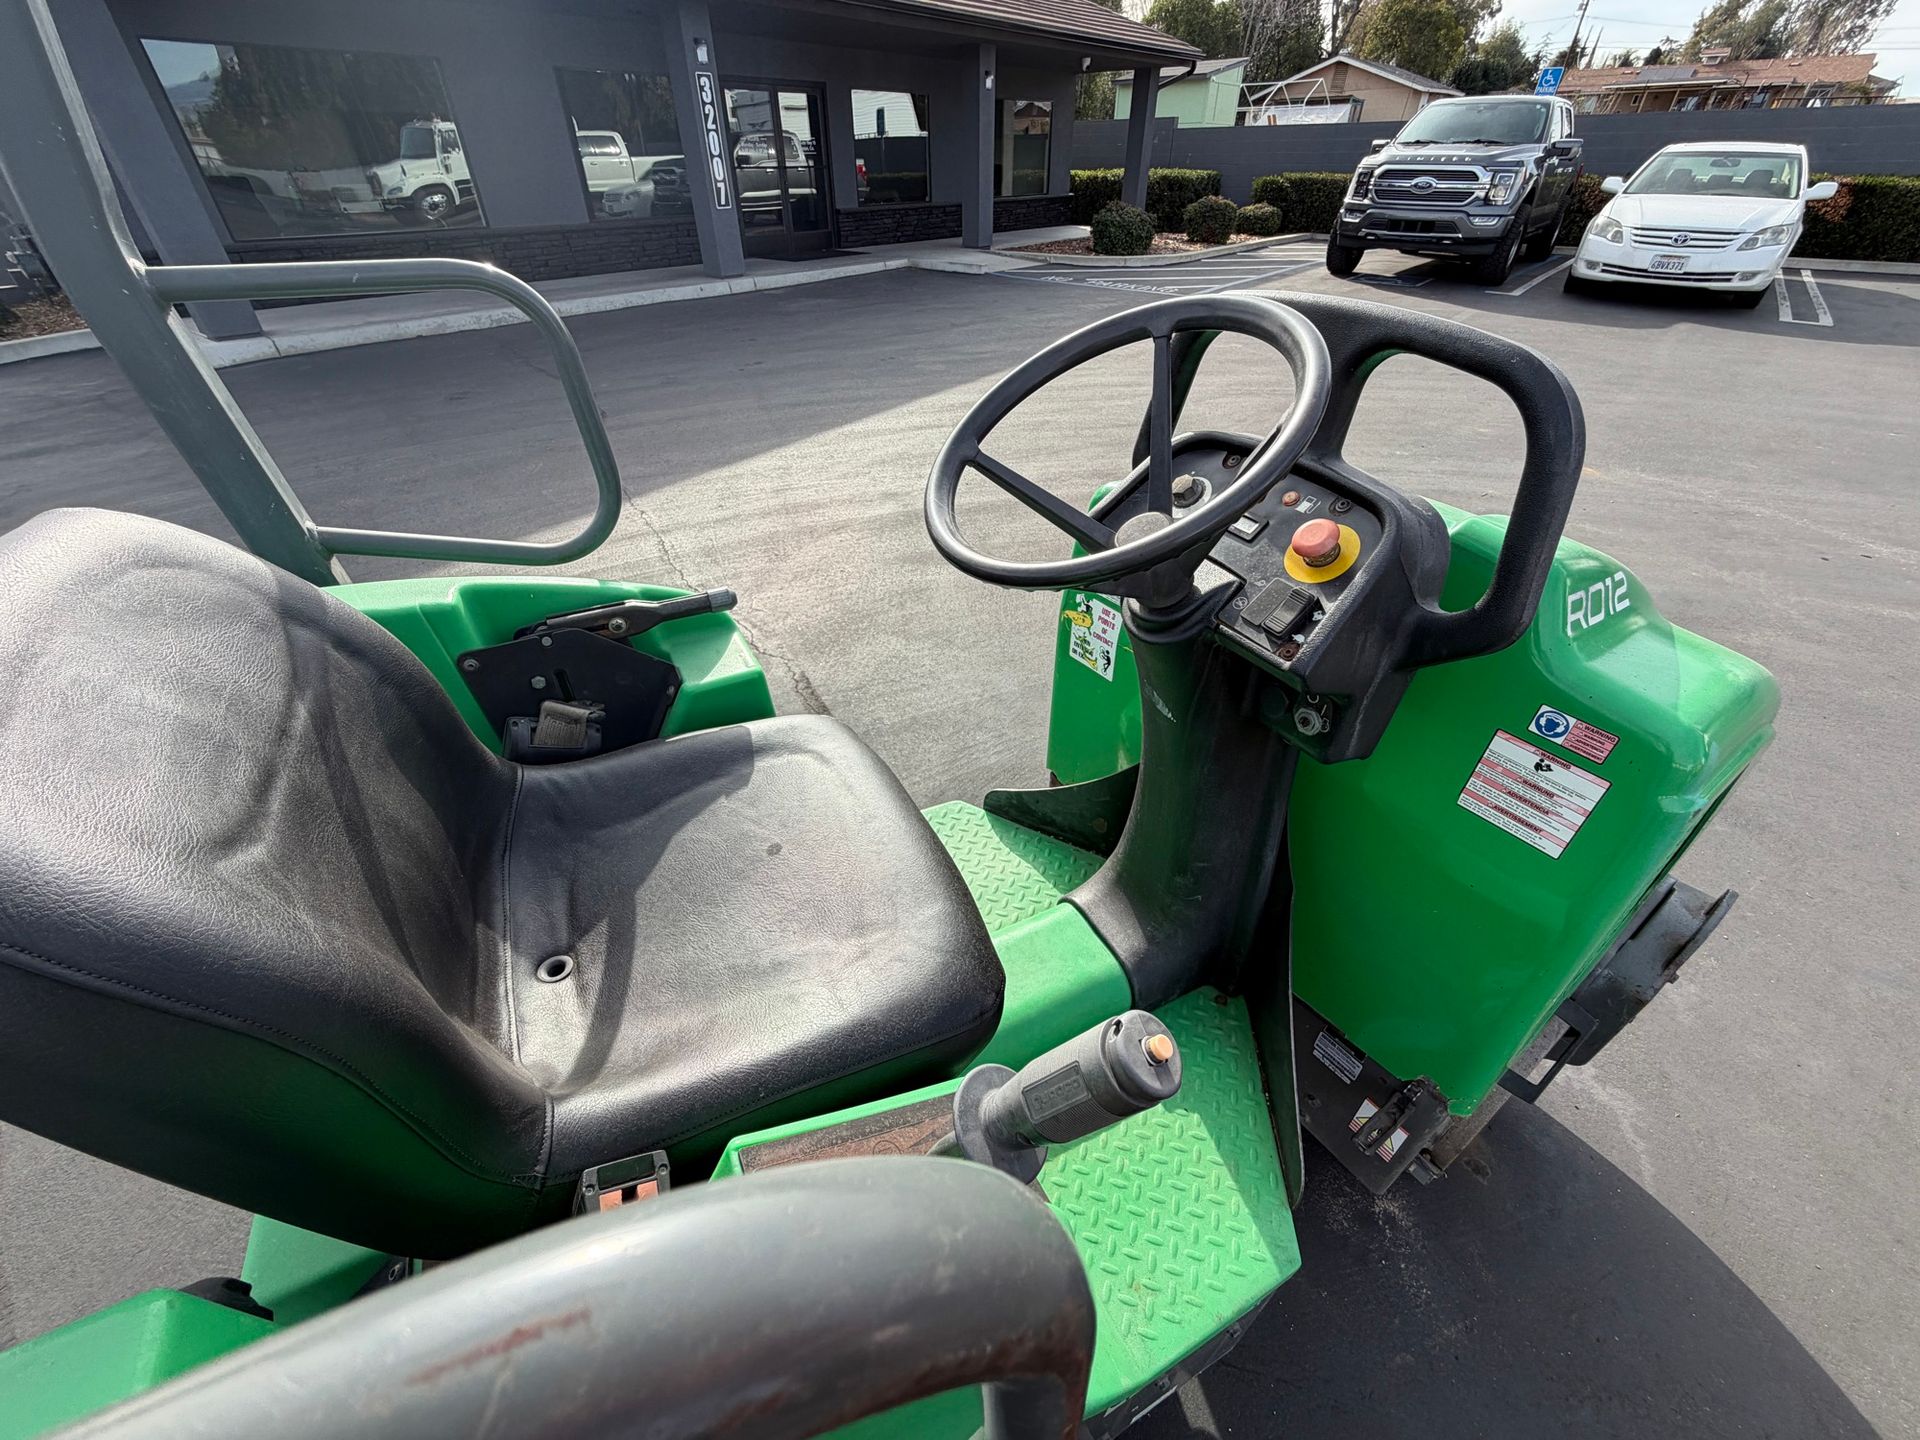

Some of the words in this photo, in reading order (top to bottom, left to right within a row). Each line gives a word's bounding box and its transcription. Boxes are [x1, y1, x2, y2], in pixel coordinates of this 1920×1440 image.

[700, 76, 726, 206] 32007
[1584, 725, 1616, 743] WARNING
[1540, 752, 1572, 770] WARNING
[1522, 779, 1555, 799] WARNUNG
[1507, 791, 1550, 815] ADVERTENCIA
[1493, 804, 1543, 834] AVERTISSEMENT
